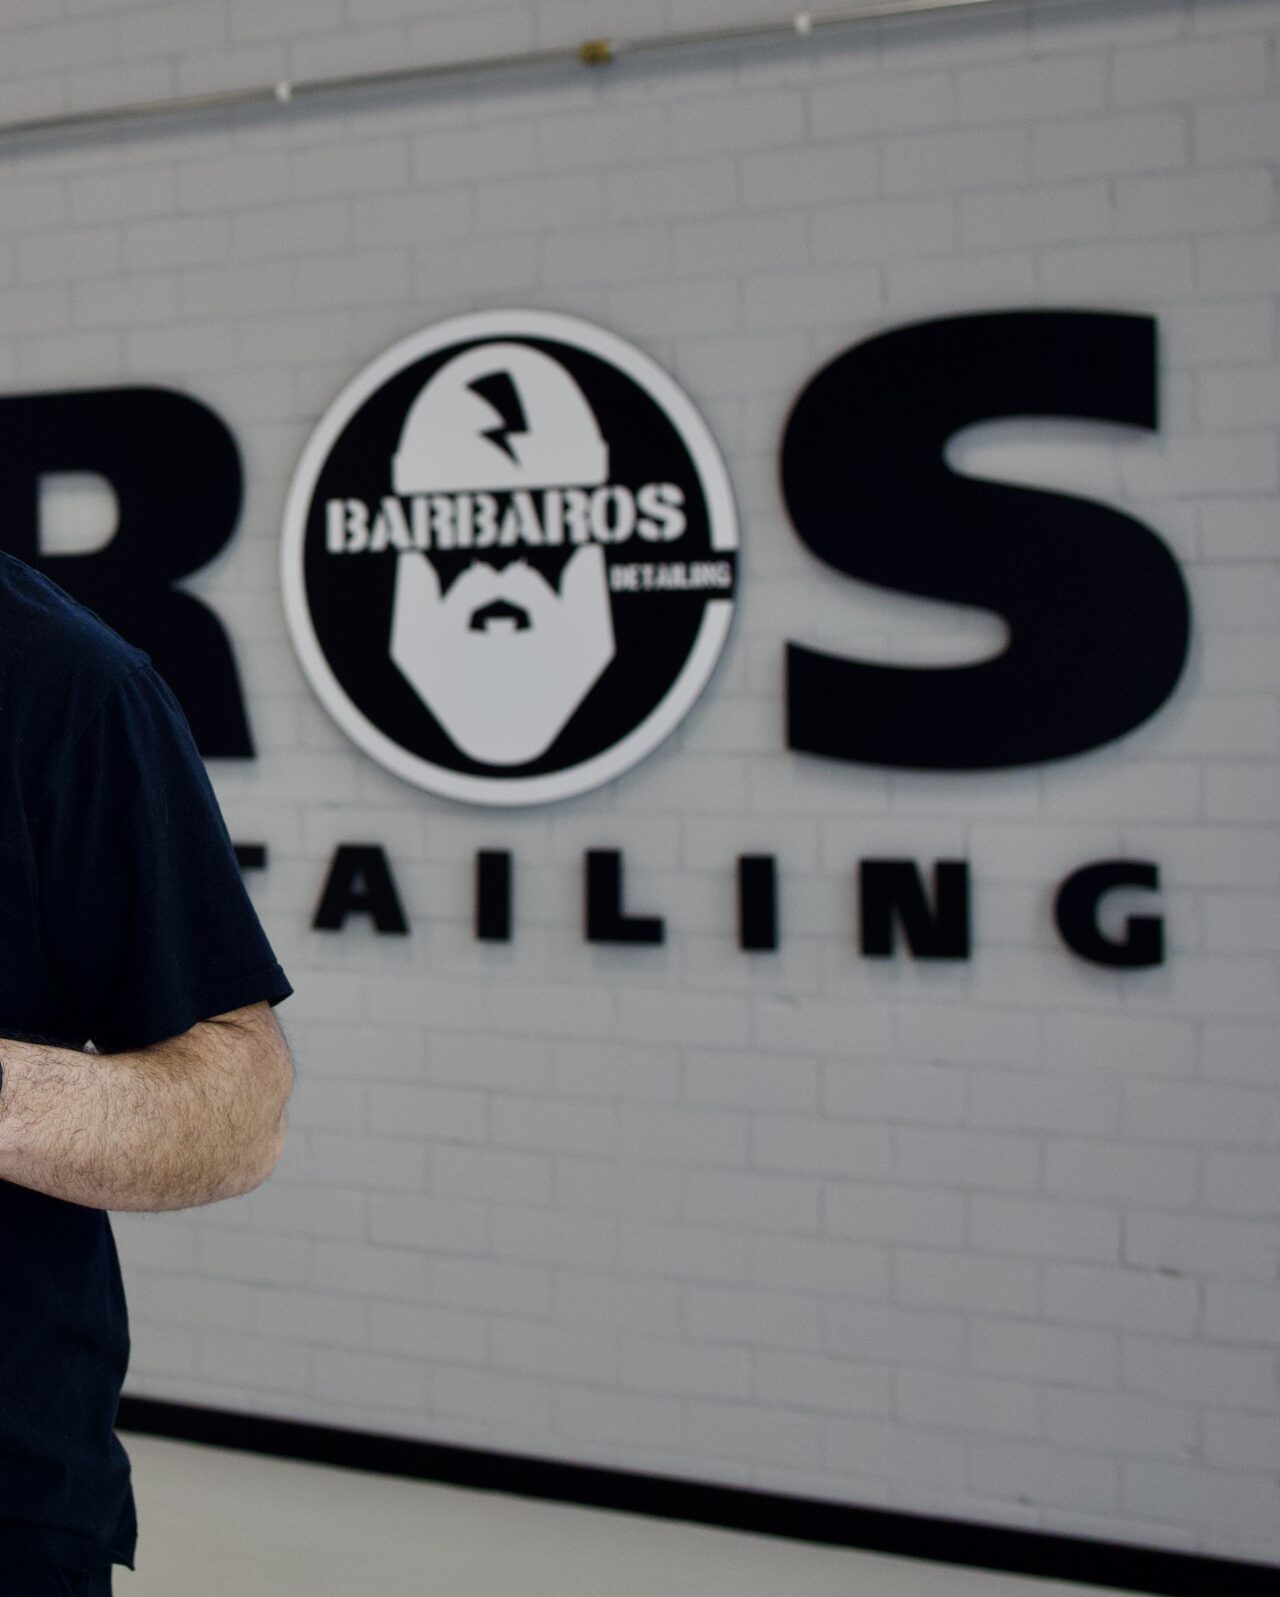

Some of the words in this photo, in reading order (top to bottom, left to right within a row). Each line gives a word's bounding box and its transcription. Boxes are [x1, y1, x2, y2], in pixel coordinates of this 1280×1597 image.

[325, 482, 688, 555] BARBAROS
[611, 560, 733, 592] DETAILING
[233, 842, 1164, 968] AILING
